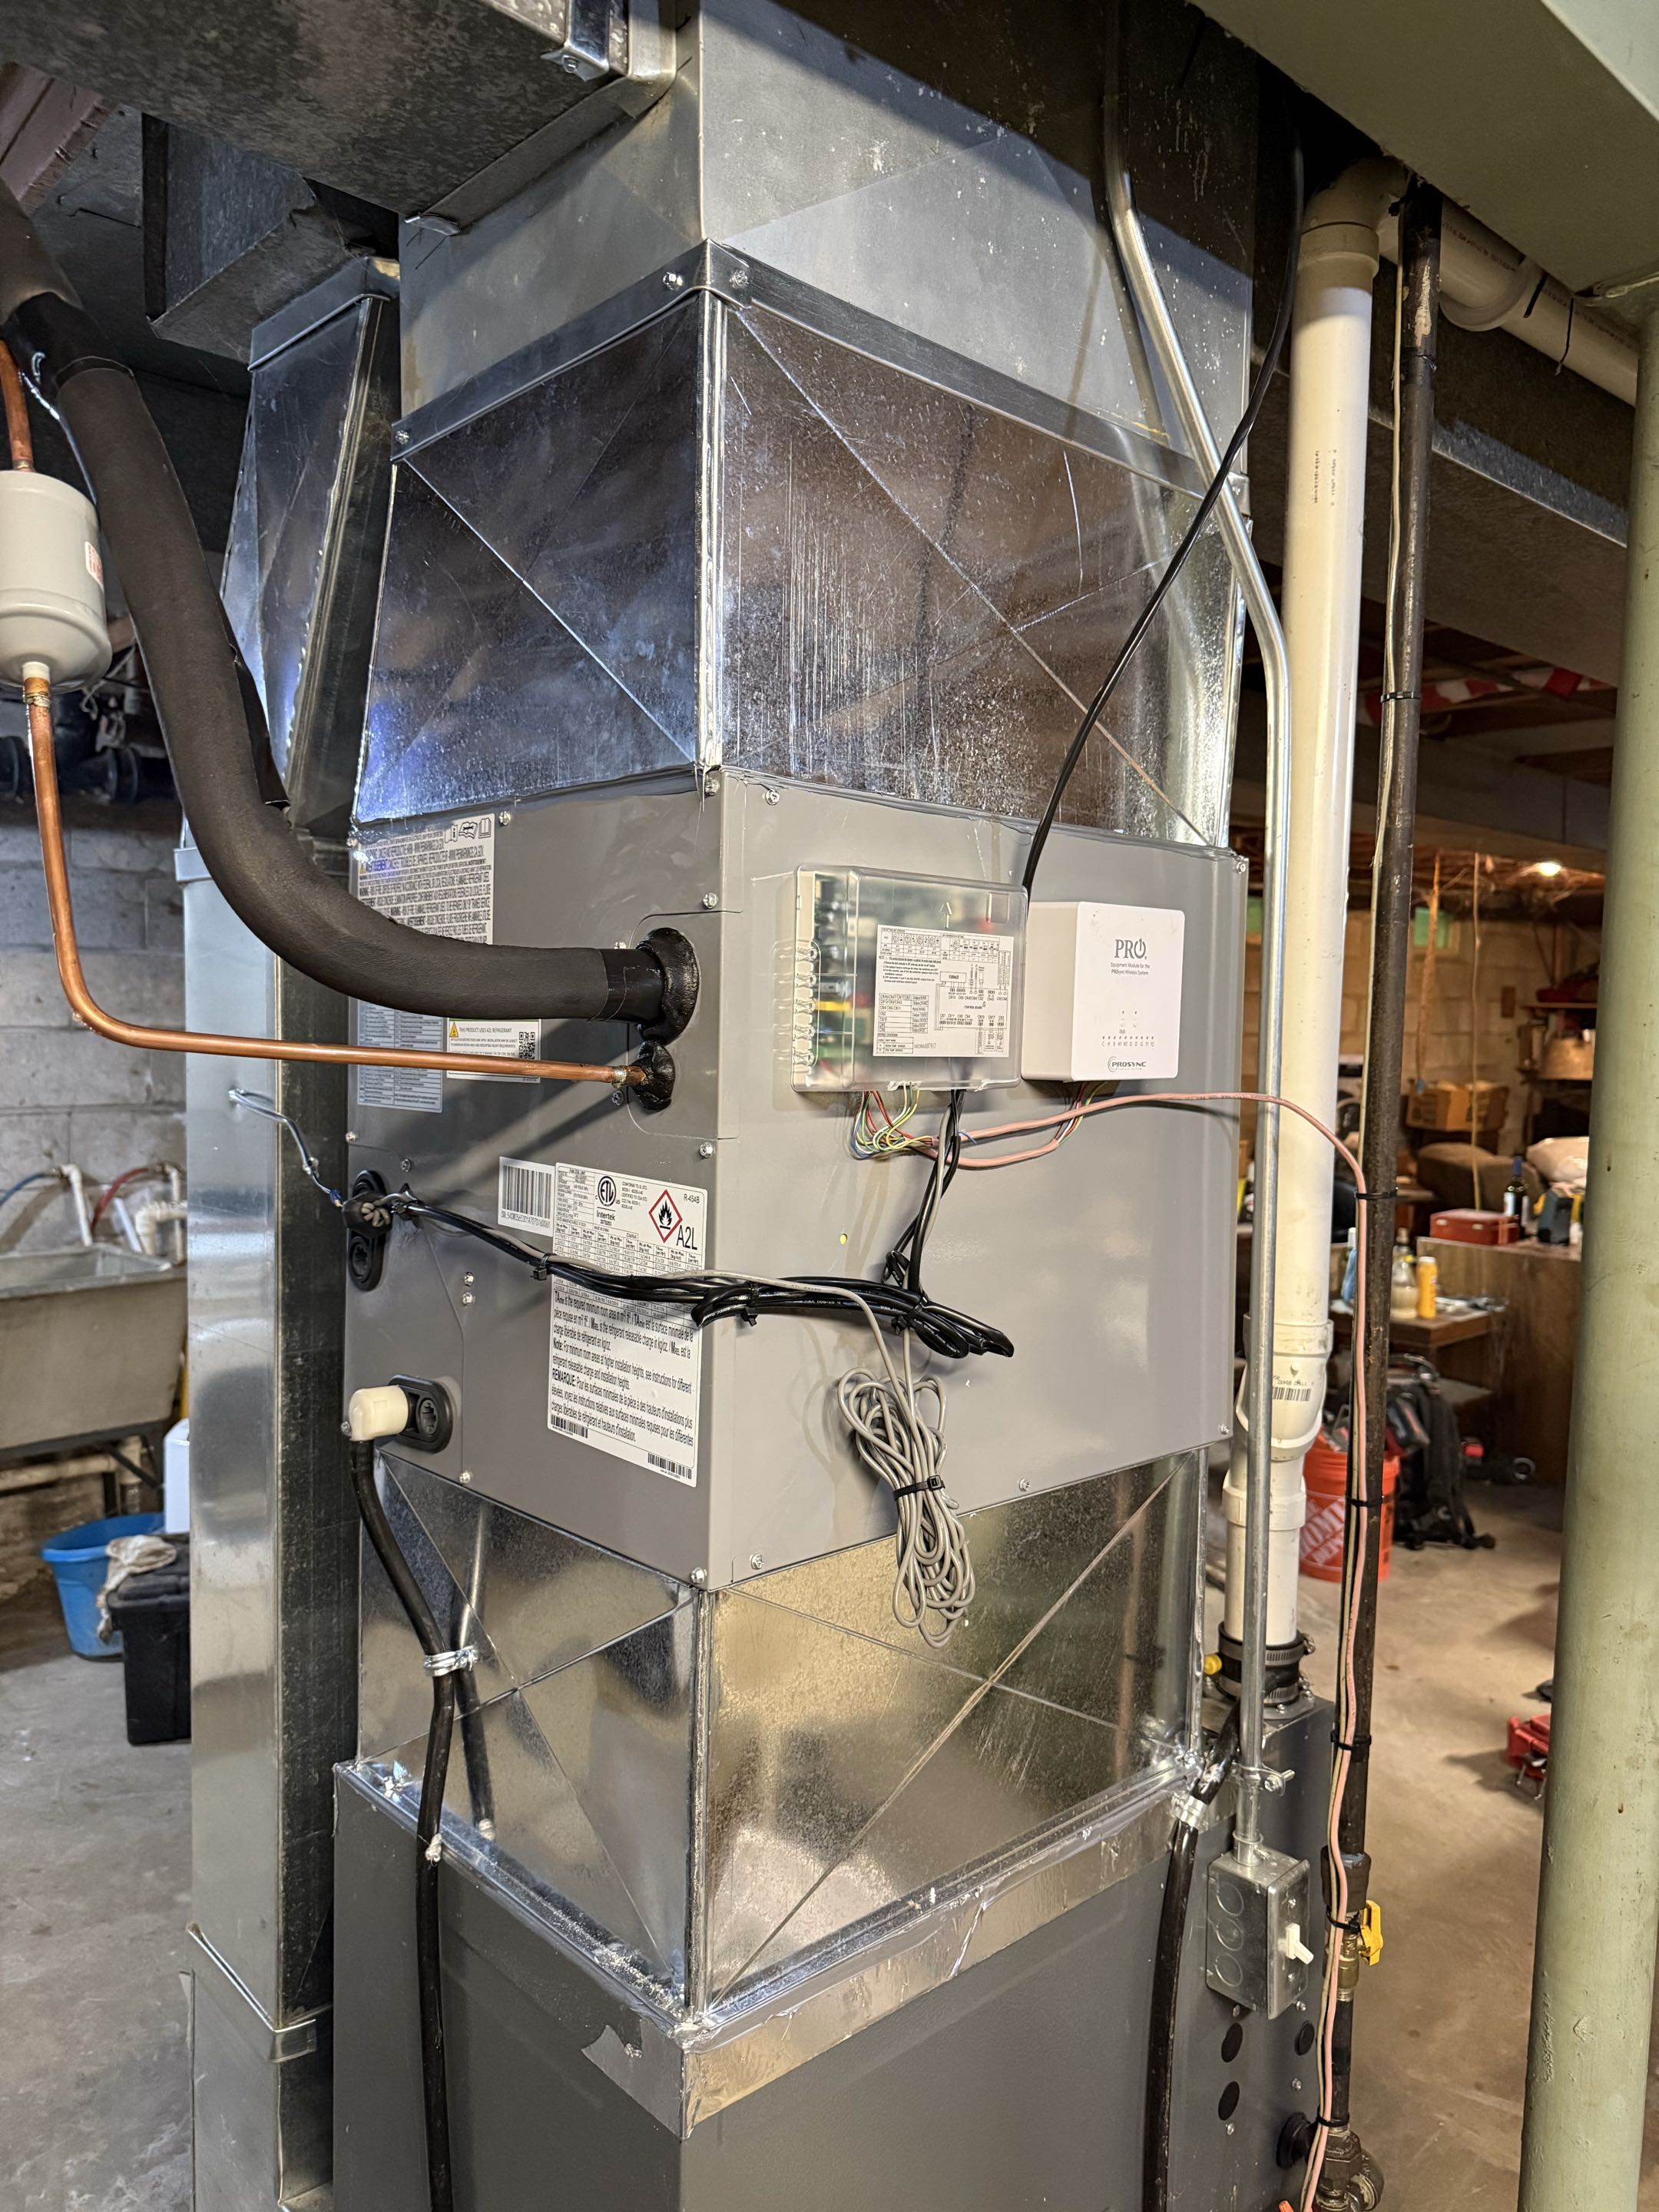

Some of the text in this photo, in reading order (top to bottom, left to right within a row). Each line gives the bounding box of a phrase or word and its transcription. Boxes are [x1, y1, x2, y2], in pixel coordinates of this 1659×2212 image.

[601, 1181, 614, 1203] ETL
[684, 1194, 700, 1204] R-454B
[596, 1210, 616, 1220] Intertek
[677, 1224, 697, 1250] A2L
[553, 1322, 563, 1337] charge
[577, 1329, 581, 1341] de
[597, 1338, 601, 1347] en
[562, 1310, 573, 1323] requise
[599, 1320, 602, 1332] is
[608, 1323, 624, 1339] refrigerant
[624, 1328, 641, 1344] releasable
[641, 1333, 654, 1349] charge
[654, 1336, 657, 1349] in
[687, 1346, 690, 1359] la
[565, 1293, 568, 1305] is
[573, 1298, 585, 1311] required
[585, 1300, 599, 1315] minimum
[600, 1306, 608, 1317] room
[616, 1308, 620, 1320] in
[651, 1318, 654, 1330] la
[654, 1320, 667, 1334] surface
[667, 1323, 684, 1339] minimale
[684, 1327, 689, 1340] de
[690, 1329, 693, 1342] la
[552, 1353, 567, 1369] refrigerant
[567, 1359, 582, 1374] releasable
[583, 1363, 593, 1379] charge
[601, 1369, 617, 1386] installation
[553, 1336, 563, 1351] Note:
[569, 1343, 582, 1357] minimum
[591, 1352, 600, 1363] areas
[600, 1353, 604, 1364] at
[604, 1353, 614, 1370] higher
[614, 1357, 631, 1373] installation
[651, 1369, 671, 1387] instructions
[677, 1378, 691, 1394] different
[551, 1367, 576, 1387] REMARQUE:
[589, 1382, 602, 1396] surfaces
[603, 1386, 618, 1402] minimales
[619, 1392, 623, 1404] de
[623, 1393, 627, 1406] la
[627, 1395, 636, 1409] pièce
[646, 1401, 661, 1418] hauteurs
[551, 1399, 562, 1415] charges
[577, 1409, 581, 1421] de
[598, 1417, 601, 1429] et
[601, 1418, 615, 1434] hauteurs
[564, 1390, 573, 1403] voyez
[578, 1392, 594, 1410] instructions
[595, 1400, 608, 1415] relatives
[614, 1408, 628, 1422] surfaces
[629, 1412, 645, 1429] minimales
[646, 1420, 660, 1434] requises
